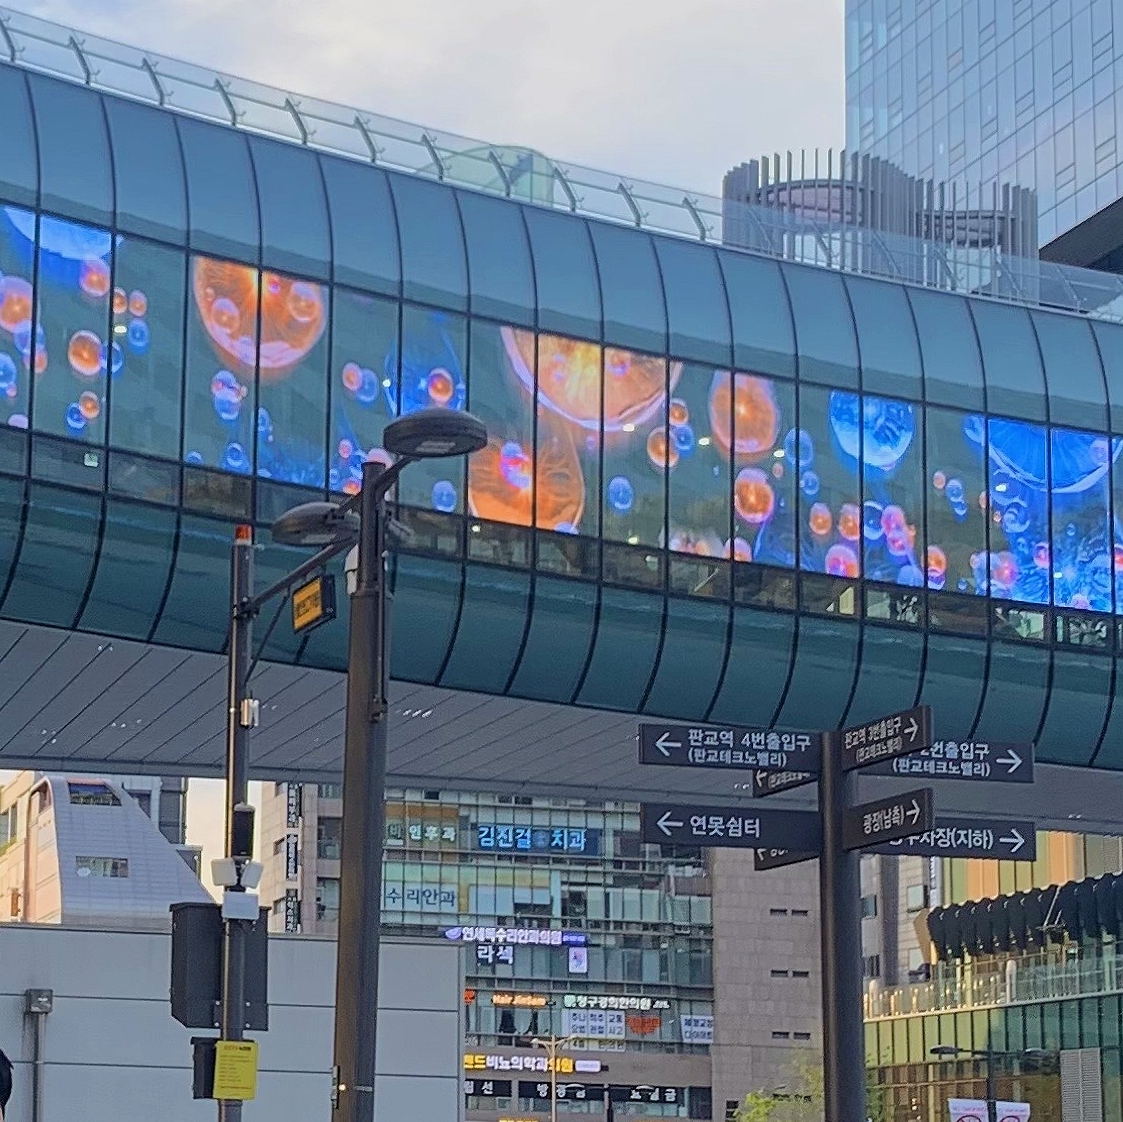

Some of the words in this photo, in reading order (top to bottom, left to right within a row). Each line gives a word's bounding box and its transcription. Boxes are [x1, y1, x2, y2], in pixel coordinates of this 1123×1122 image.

[688, 728, 734, 748] 판교역
[740, 731, 811, 752] 4번출입구
[688, 746, 787, 768] (판교테크노밸리)
[892, 757, 991, 778] (판교테크노밸리)
[689, 815, 760, 838] 연못쉼터
[862, 804, 905, 835] 광장(남측)
[550, 828, 588, 851] 치과
